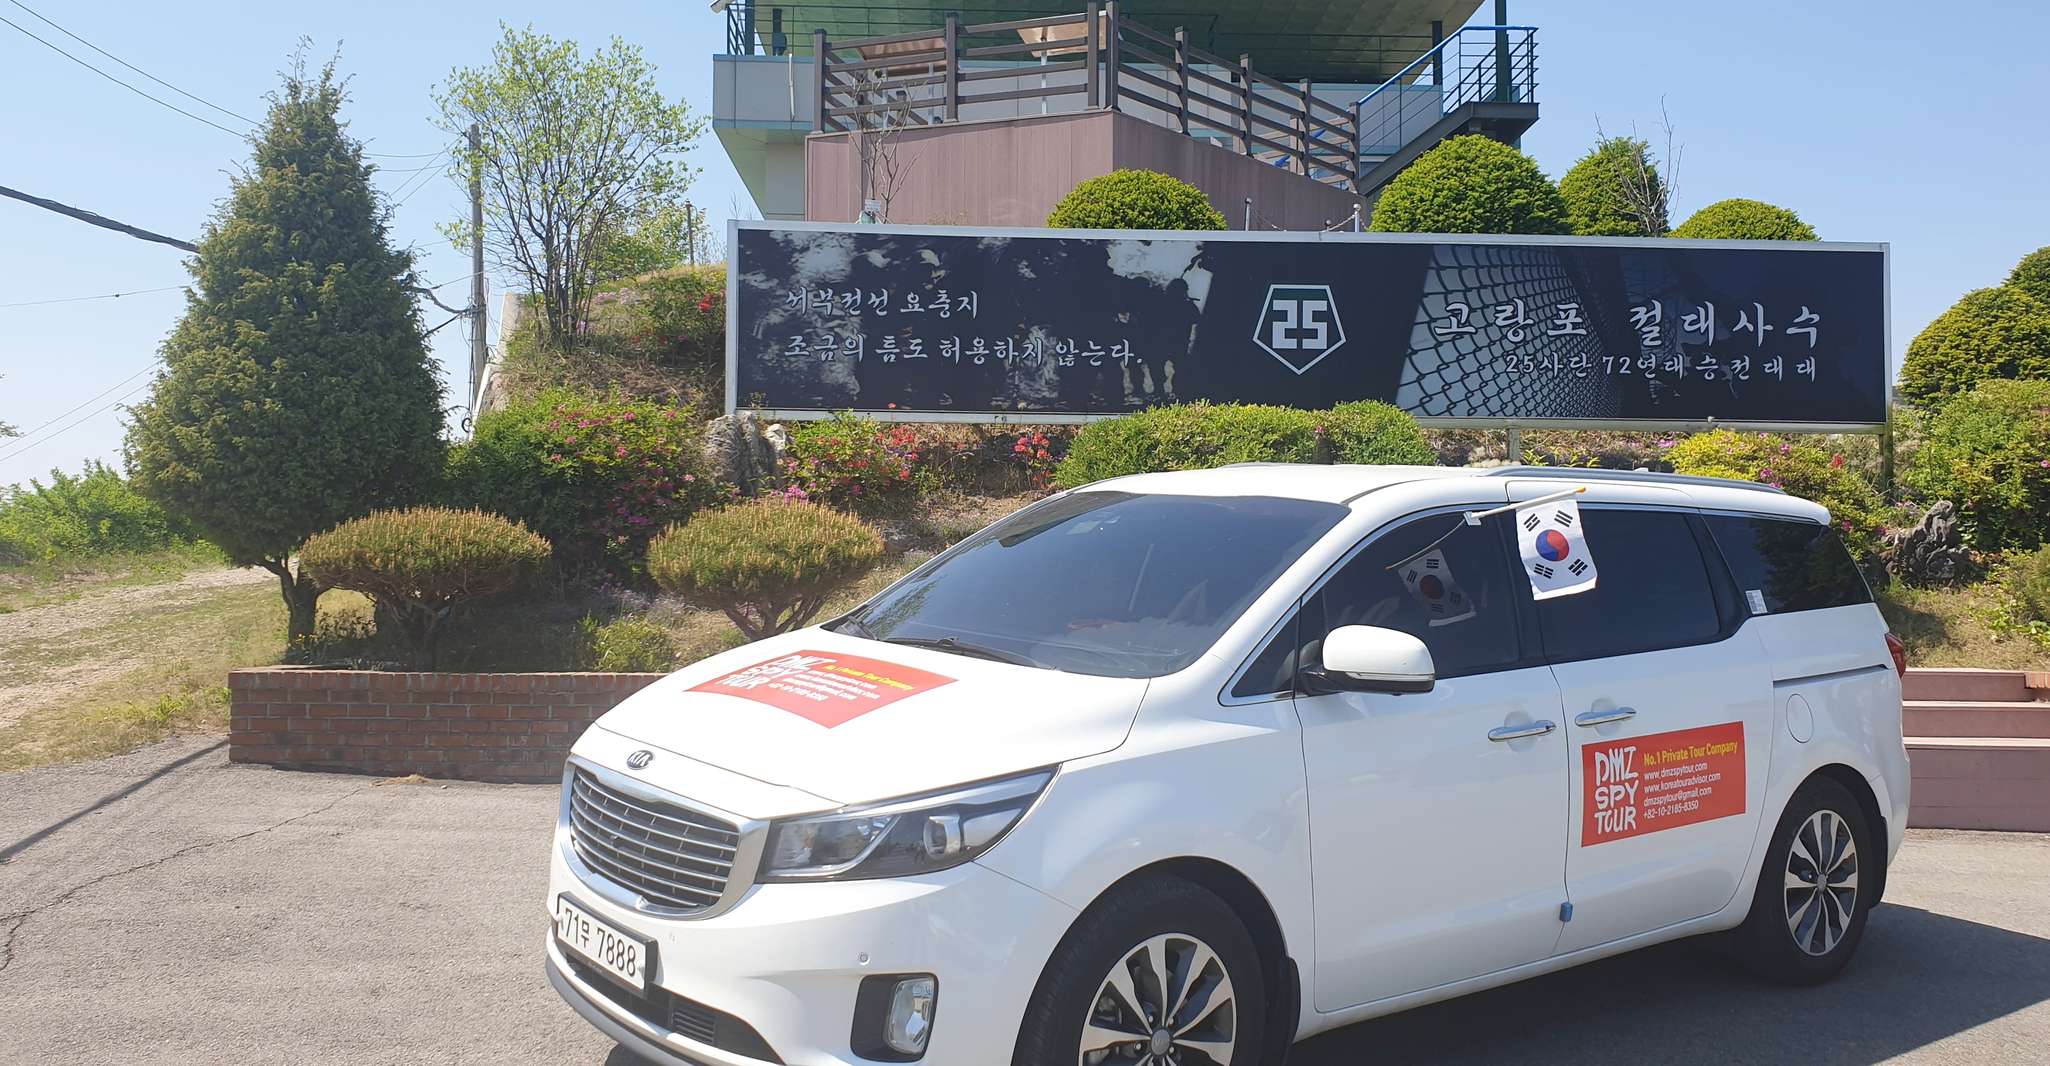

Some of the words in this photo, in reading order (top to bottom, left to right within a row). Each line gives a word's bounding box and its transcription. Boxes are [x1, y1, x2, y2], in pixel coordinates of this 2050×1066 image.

[785, 286, 889, 317] 서부전선
[899, 290, 979, 319] 요충지
[1272, 299, 1328, 349] 25
[1433, 298, 1588, 343] 고랑포
[1629, 299, 1821, 349] 절대사수
[784, 333, 865, 363] 조금의
[875, 335, 929, 363] 틈도
[938, 335, 1044, 367] 허용하지
[1054, 337, 1143, 368] 않는다.
[1505, 352, 1592, 378] 25사단
[1594, 746, 1639, 786] DMZ
[1661, 749, 1689, 763] Private
[1689, 745, 1707, 758] Tour
[1706, 741, 1739, 757] Company
[1594, 780, 1639, 810] SPY
[1594, 805, 1637, 835] TOUR
[565, 907, 590, 948] 71무
[597, 927, 636, 977] 7888
